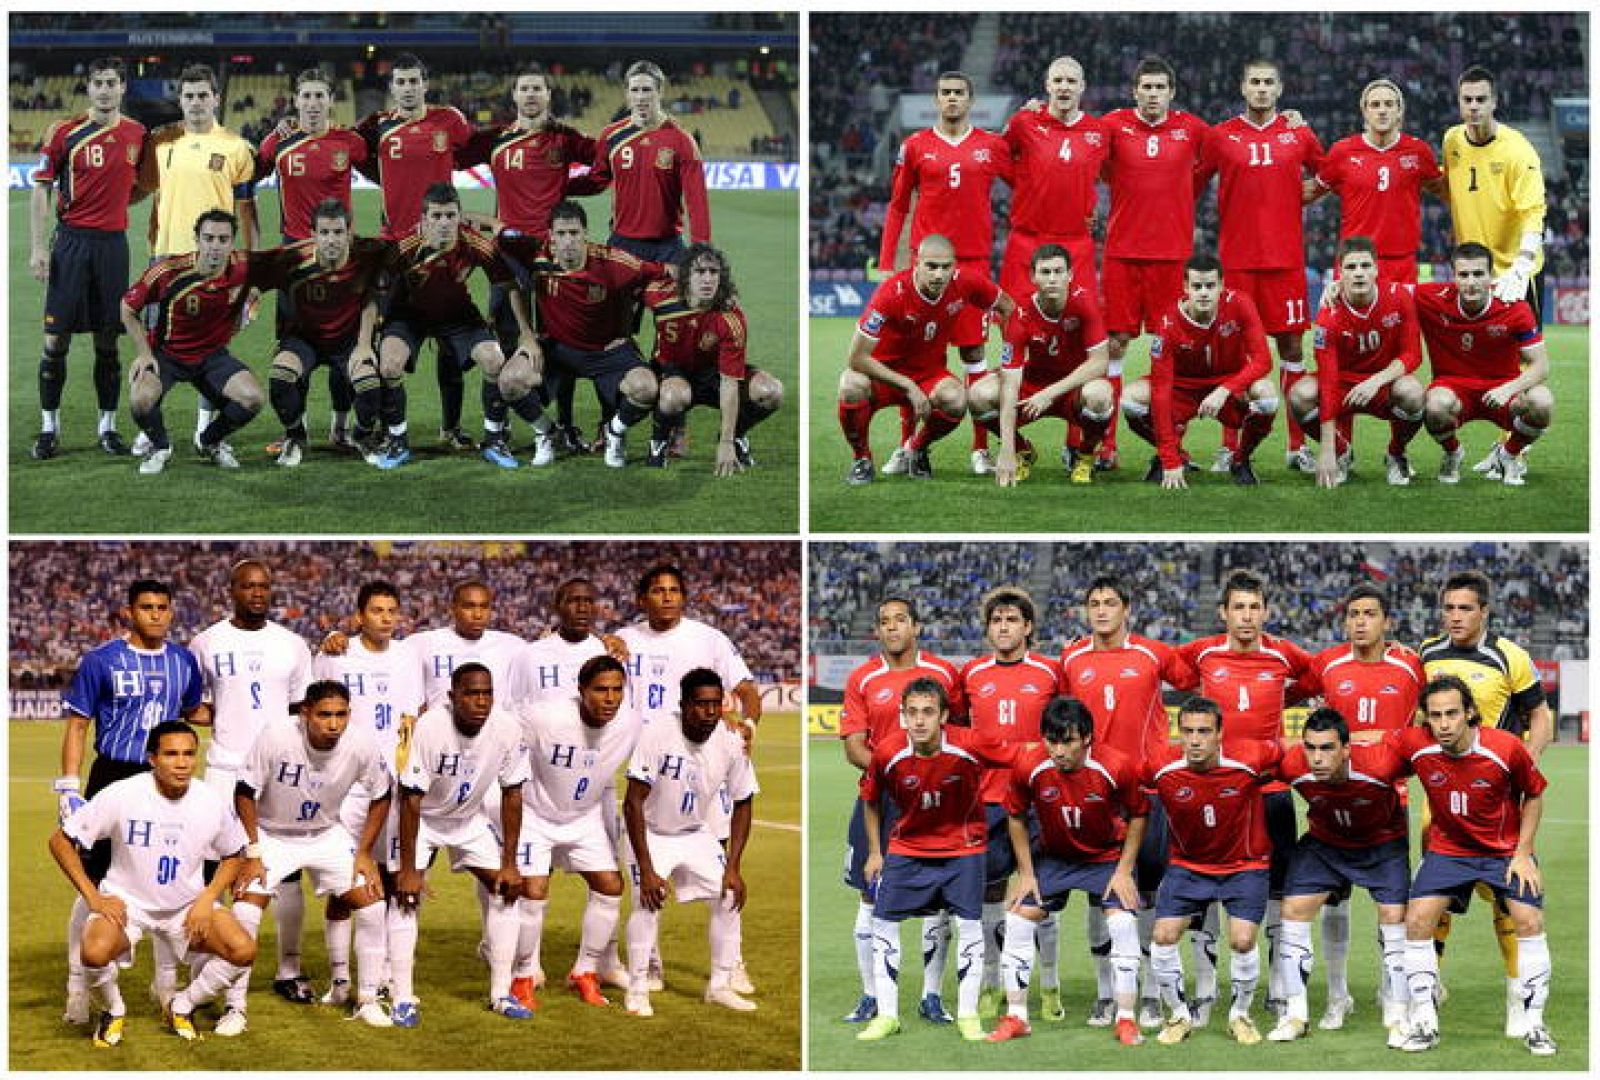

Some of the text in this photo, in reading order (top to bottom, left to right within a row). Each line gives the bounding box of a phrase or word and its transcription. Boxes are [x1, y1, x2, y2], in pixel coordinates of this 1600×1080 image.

[86, 145, 104, 167] 18
[389, 137, 402, 159] 2
[1058, 138, 1072, 162] 4
[1146, 135, 1159, 157] 6
[1248, 142, 1273, 165] 11
[287, 154, 305, 176] 15
[504, 148, 523, 170] 14
[621, 147, 634, 169] 9
[949, 163, 961, 188] 5
[1377, 166, 1390, 191] 3
[1468, 167, 1478, 192] 1
[1286, 299, 1305, 325] 11
[666, 321, 678, 343] 5
[1357, 329, 1380, 353] 10
